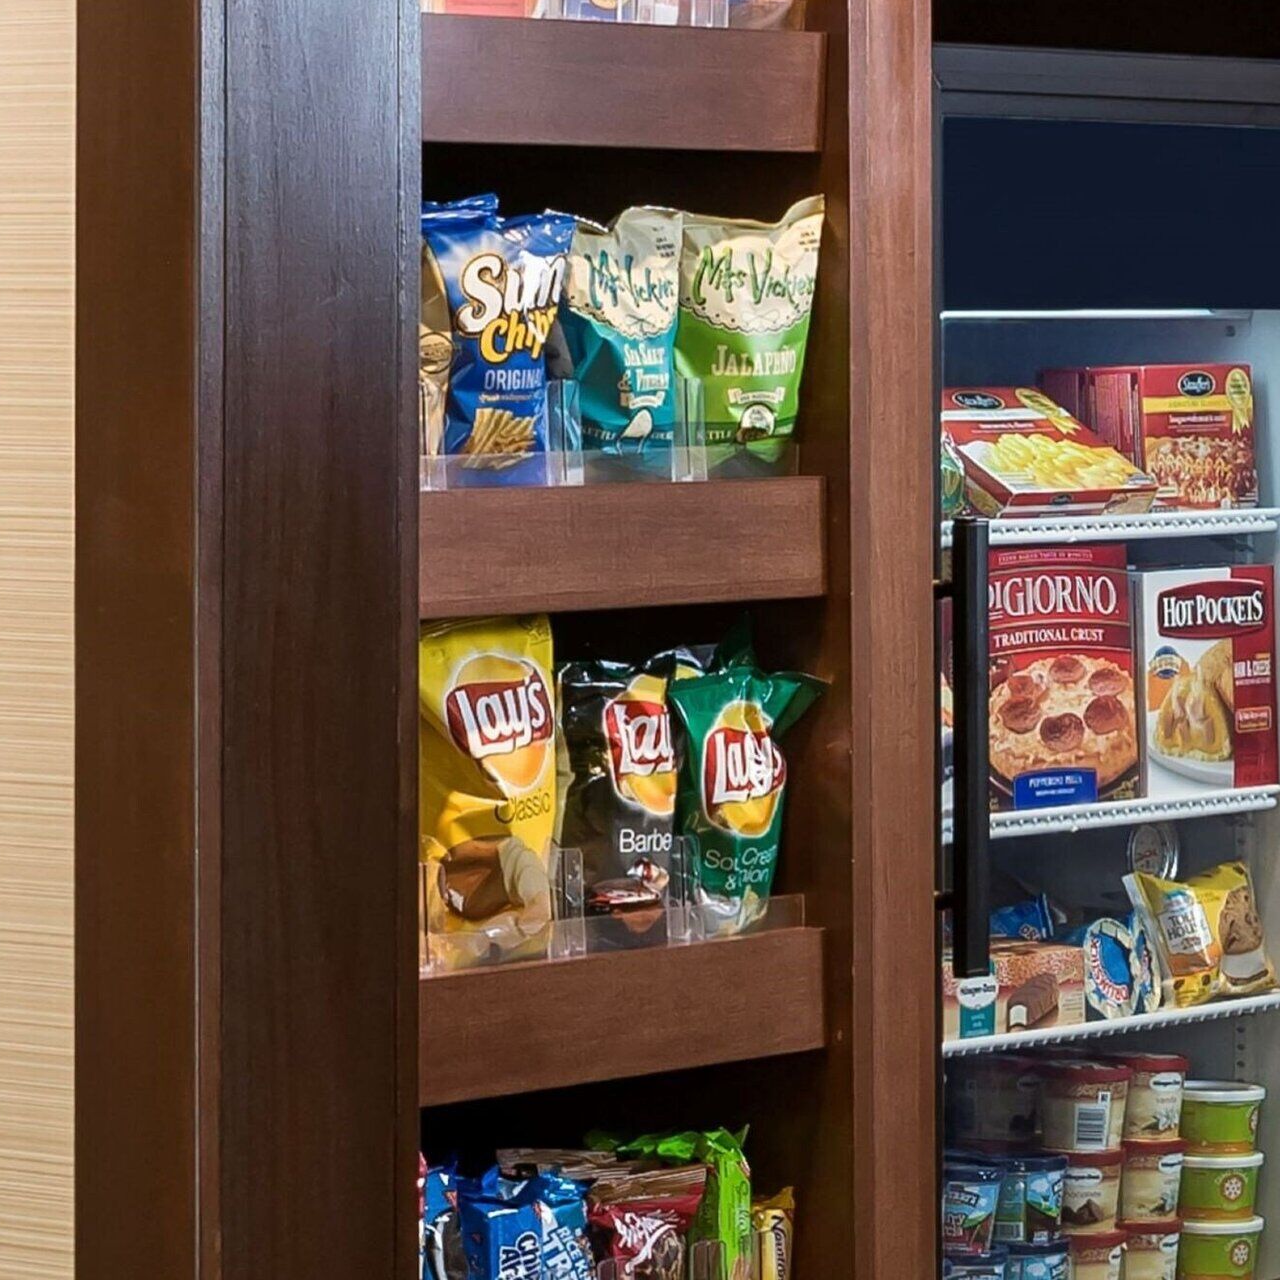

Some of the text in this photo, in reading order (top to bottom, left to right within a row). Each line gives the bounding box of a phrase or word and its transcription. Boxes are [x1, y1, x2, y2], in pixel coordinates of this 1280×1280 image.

[1163, 590, 1264, 628] HOT POCKETS
[993, 628, 1105, 648] TRADITIONAL CRUST
[453, 675, 546, 760] Lay's
[495, 789, 551, 825] Classic
